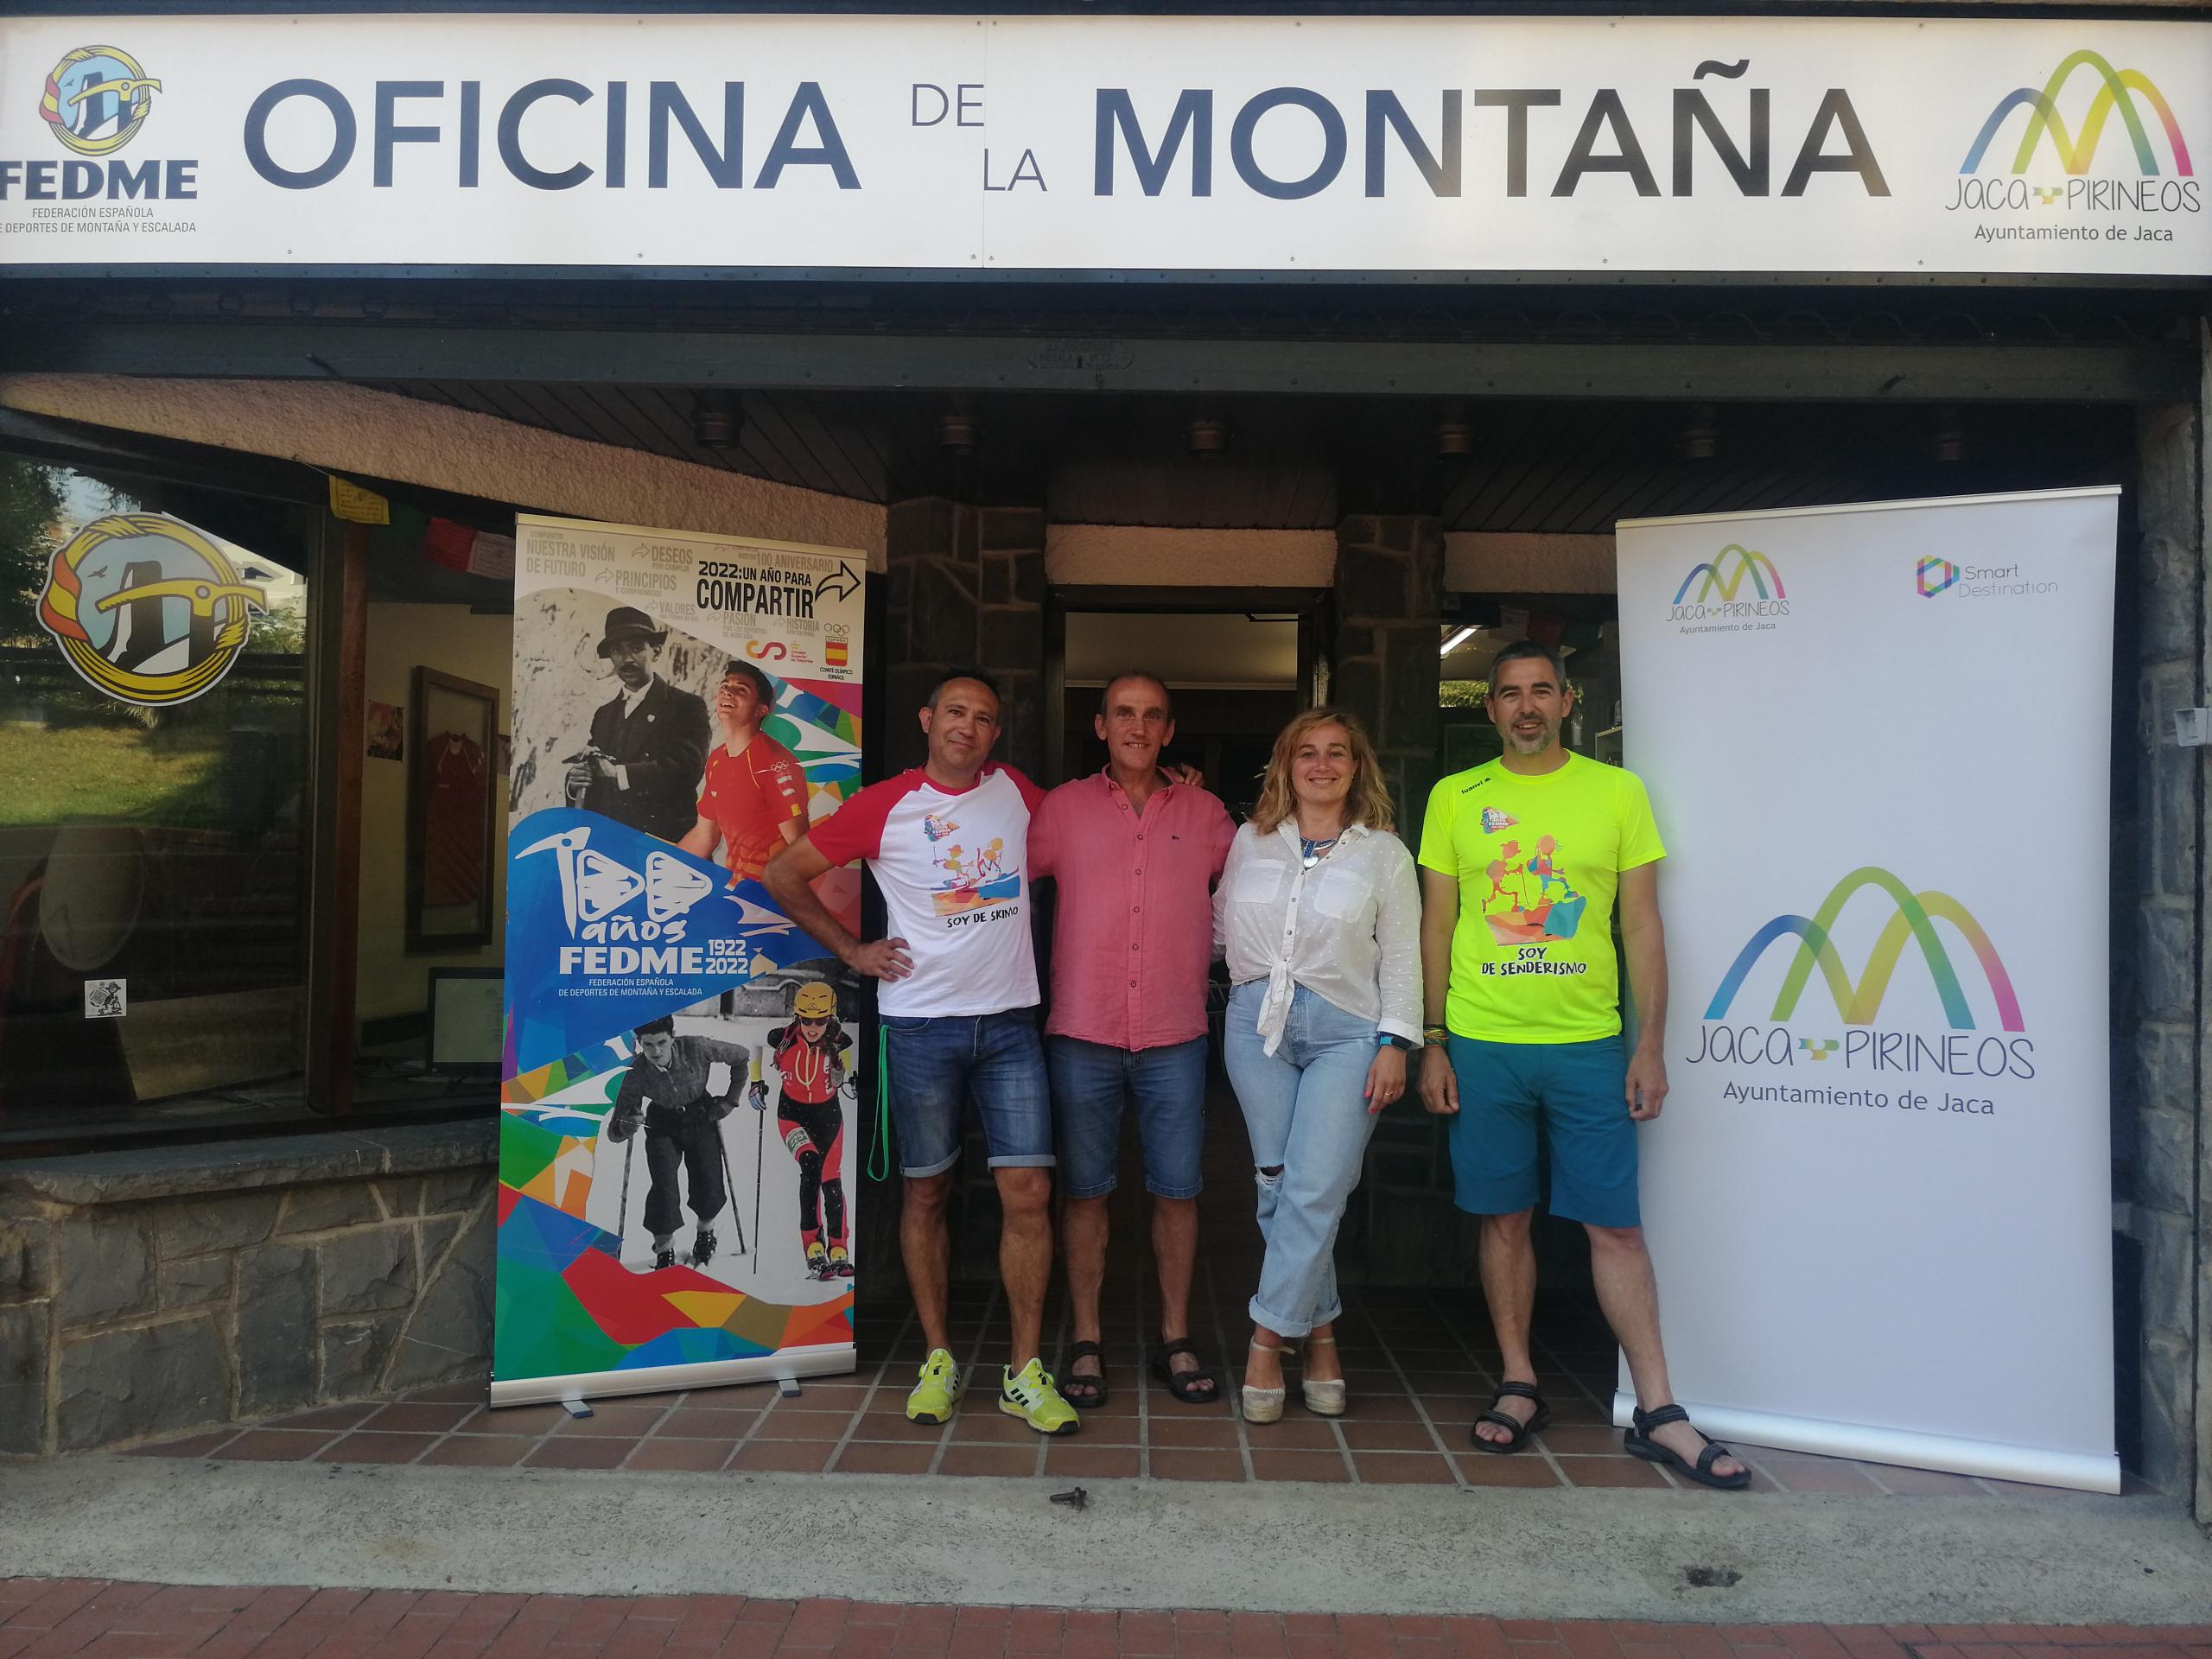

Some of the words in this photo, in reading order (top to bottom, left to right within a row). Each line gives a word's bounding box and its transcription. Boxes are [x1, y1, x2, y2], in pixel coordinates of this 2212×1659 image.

[245, 79, 861, 190] OFICINA
[912, 84, 983, 127] DE
[983, 148, 1047, 192] LA
[1095, 60, 1891, 200] MONTAÑA
[0, 160, 198, 200] FEDME
[2067, 178, 2201, 213] PIRINEOS
[32, 206, 96, 218] FEDERACIÓN
[99, 206, 154, 218] ESPAÑOLA
[5, 222, 58, 232] DEPORTES
[60, 222, 74, 232] DE
[77, 220, 130, 232] MONTAÑA
[133, 222, 139, 232] Y
[142, 222, 196, 232] ESCALADA
[1974, 225, 2099, 244] Ayuntamiento
[2106, 225, 2127, 241] de
[2133, 225, 2174, 242] Jaca
[526, 538, 577, 556] NUESTRA
[580, 543, 616, 563] VISIÓN
[652, 545, 694, 565] DESEOS
[525, 557, 543, 574] DE
[543, 559, 587, 578] FUTURO
[774, 554, 834, 574] ANIVERSARIO
[1964, 563, 2019, 582] Smart
[614, 569, 677, 591] PRINCIPIOS
[760, 567, 782, 583] AÑO
[785, 573, 812, 587] PARA
[696, 578, 814, 619] COMPARTIR
[1959, 579, 2058, 599] Destination
[658, 601, 696, 616] VALORES
[1723, 600, 1789, 618] PIRINEOS
[786, 617, 820, 632] HISTORIA
[1679, 624, 1739, 635] Ayuntamiento
[1742, 622, 1753, 631] de
[1460, 779, 1484, 795] luanvi
[947, 916, 969, 928] SOY
[973, 912, 987, 923] DE
[991, 906, 1019, 921] SKIMO
[581, 914, 688, 944] años
[709, 939, 747, 957] 1922
[1517, 946, 1548, 961] SOY
[559, 946, 704, 975] FEDME
[705, 957, 748, 975] 2022
[1481, 962, 1496, 976] DE
[1500, 961, 1586, 976] SENDERISMO
[588, 977, 635, 987] FEDERACIÓN
[636, 976, 674, 986] ESPAÑOLA
[620, 987, 658, 996] MONTAÑA
[665, 988, 702, 996] ESCALADA
[1846, 1029, 2035, 1079] PIRINEOS
[1723, 1080, 1890, 1109] Ayuntamiento
[1897, 1090, 1929, 1110] de
[1938, 1091, 1995, 1116] Jaca
